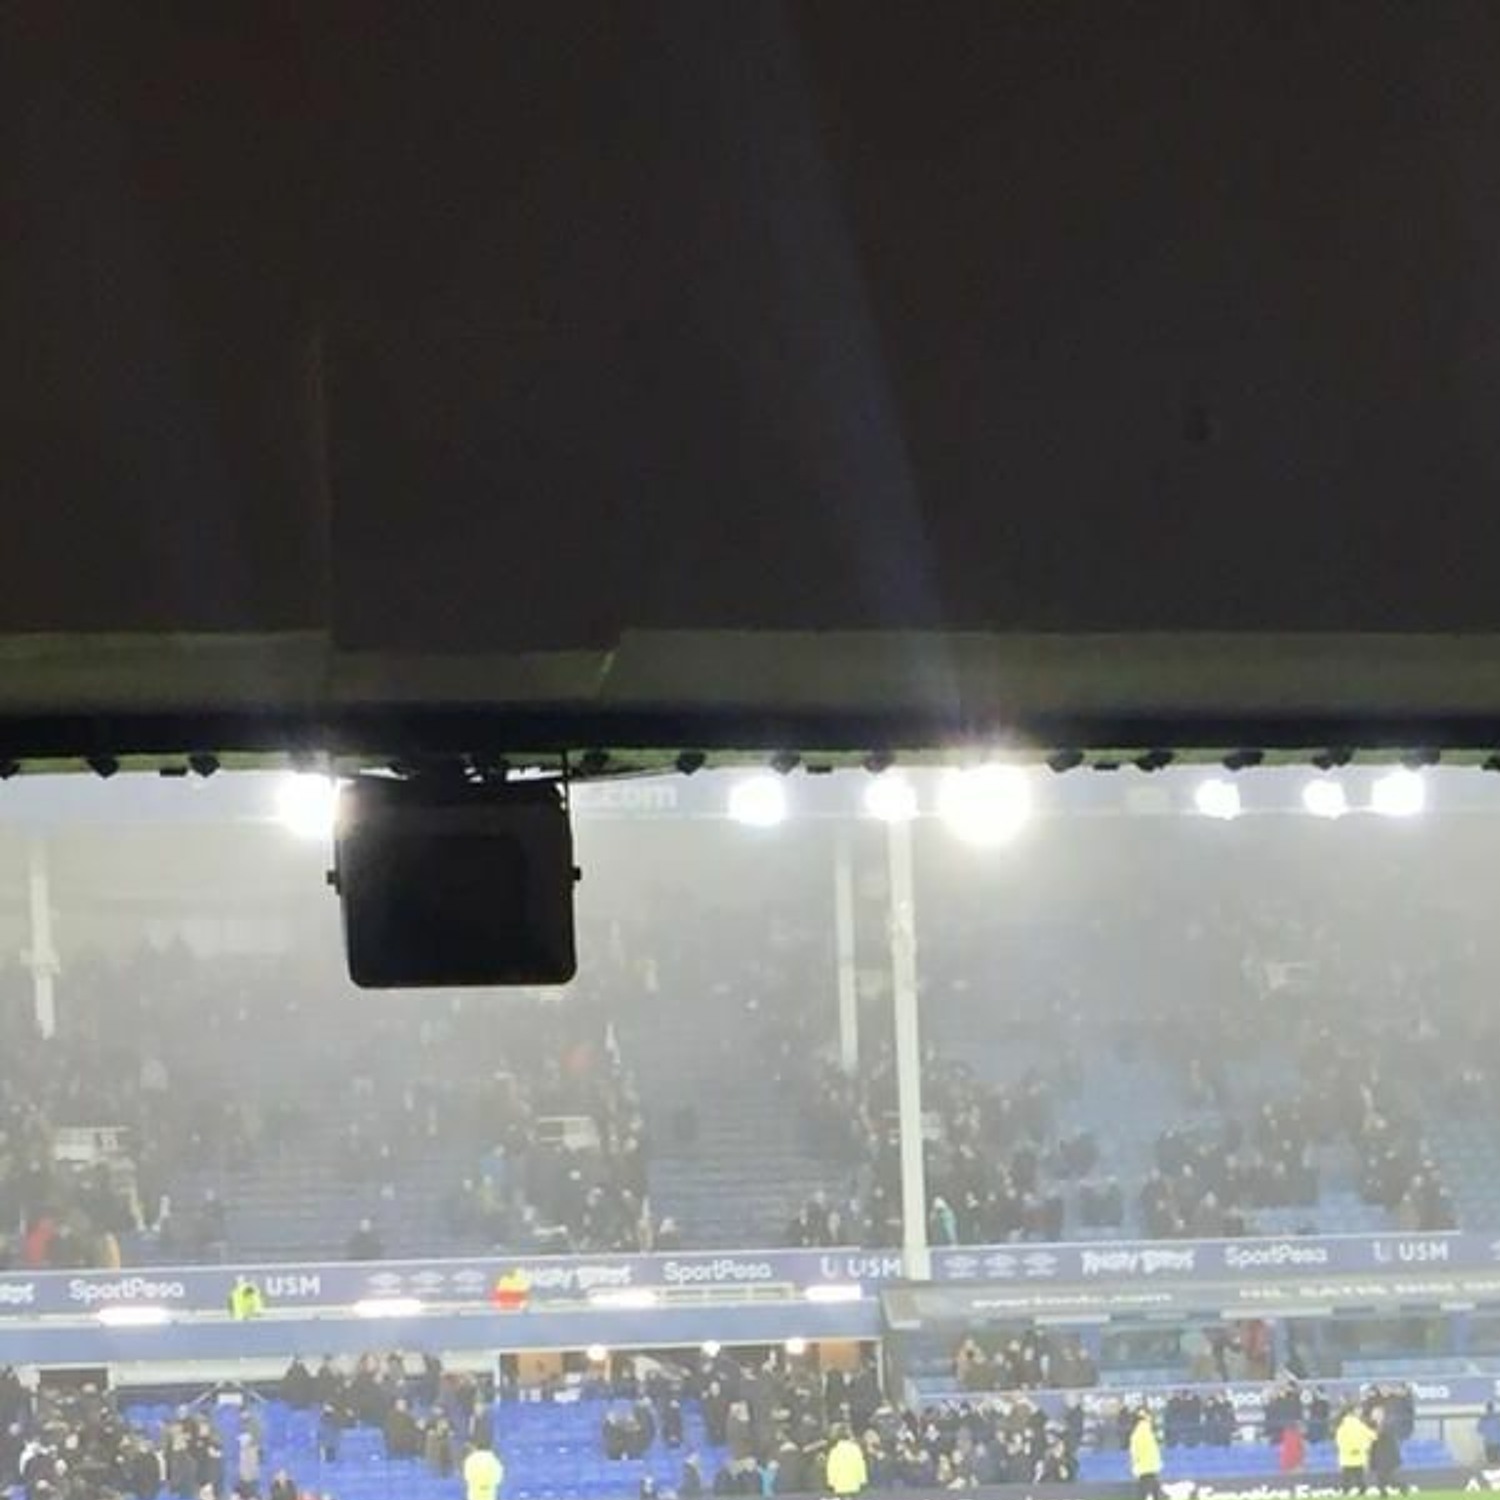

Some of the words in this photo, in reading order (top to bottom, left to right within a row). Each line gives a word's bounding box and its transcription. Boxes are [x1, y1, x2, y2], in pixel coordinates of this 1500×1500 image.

[1224, 1242, 1328, 1267] SportPesa
[1400, 1242, 1449, 1261] USM
[664, 1259, 772, 1281] SportPesa
[847, 1260, 901, 1277] USM
[69, 1277, 184, 1300] SportPesa
[265, 1275, 321, 1295] USM
